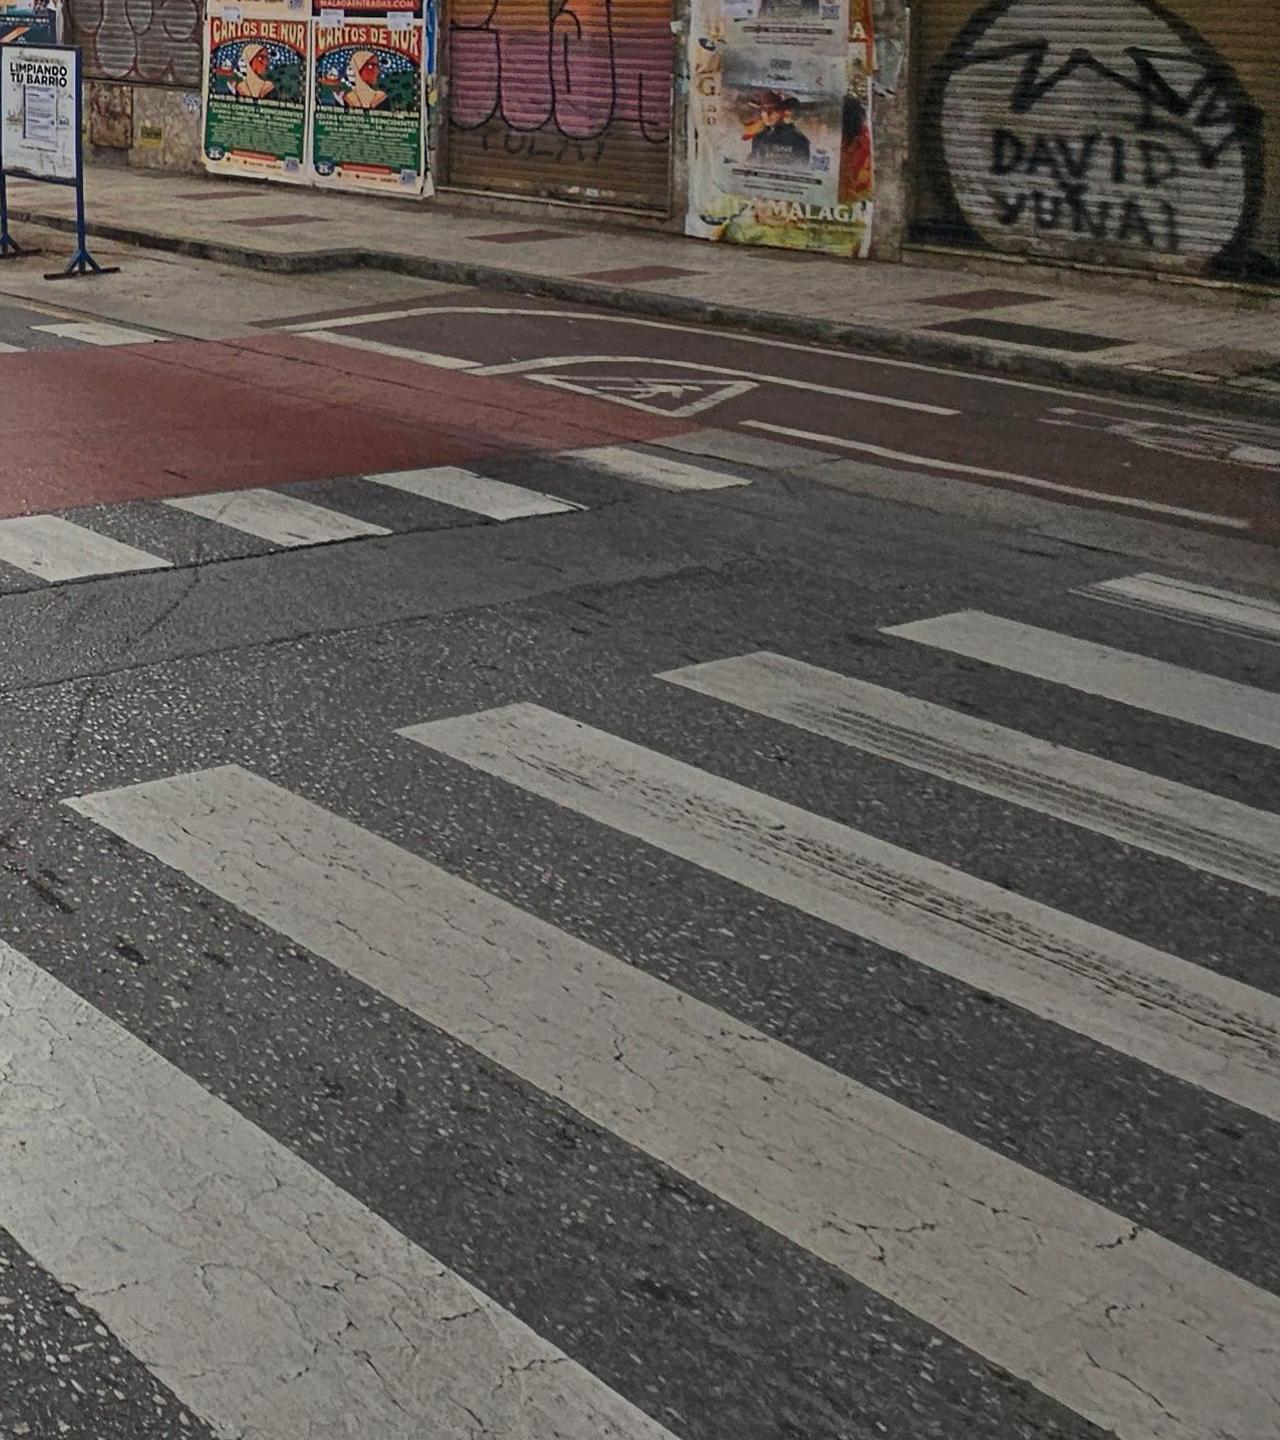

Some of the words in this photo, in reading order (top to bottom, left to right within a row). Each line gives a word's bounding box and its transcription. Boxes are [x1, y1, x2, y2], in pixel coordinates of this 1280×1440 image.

[213, 20, 258, 43] CANTOS
[260, 22, 278, 38] DE
[281, 23, 306, 51] NUR
[318, 26, 367, 50] CANTOS
[370, 27, 388, 45] DE
[391, 28, 419, 56] NUR
[10, 62, 68, 77] LIMPIANDO
[10, 72, 24, 83] TU
[26, 73, 68, 88] BARRIO
[992, 128, 1175, 187] DAVID
